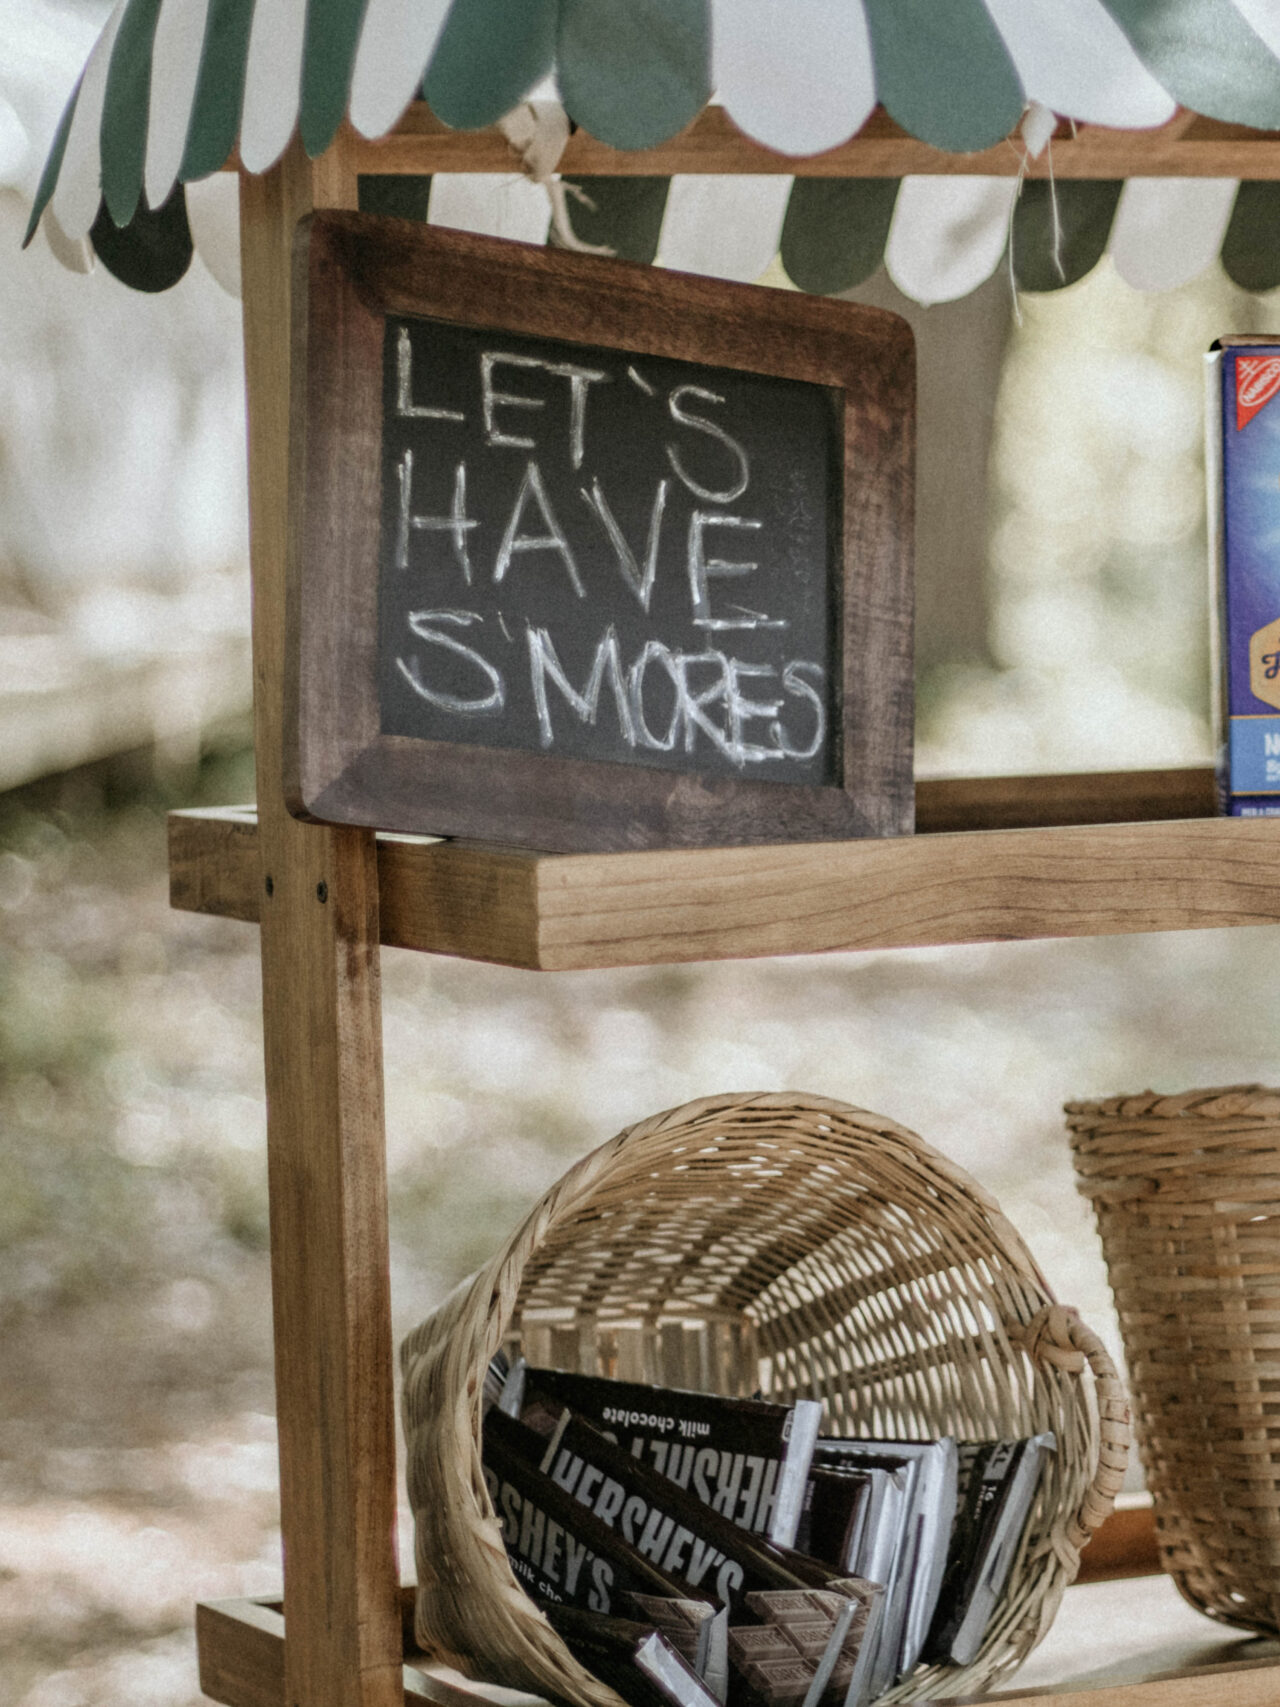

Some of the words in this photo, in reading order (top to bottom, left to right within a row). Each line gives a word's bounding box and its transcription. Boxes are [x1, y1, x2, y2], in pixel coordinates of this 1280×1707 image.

[398, 327, 749, 503] LET'S
[397, 449, 786, 630] HAVE
[397, 609, 825, 769] S'MORES
[602, 1406, 675, 1434] chocolate
[678, 1419, 710, 1438] milk
